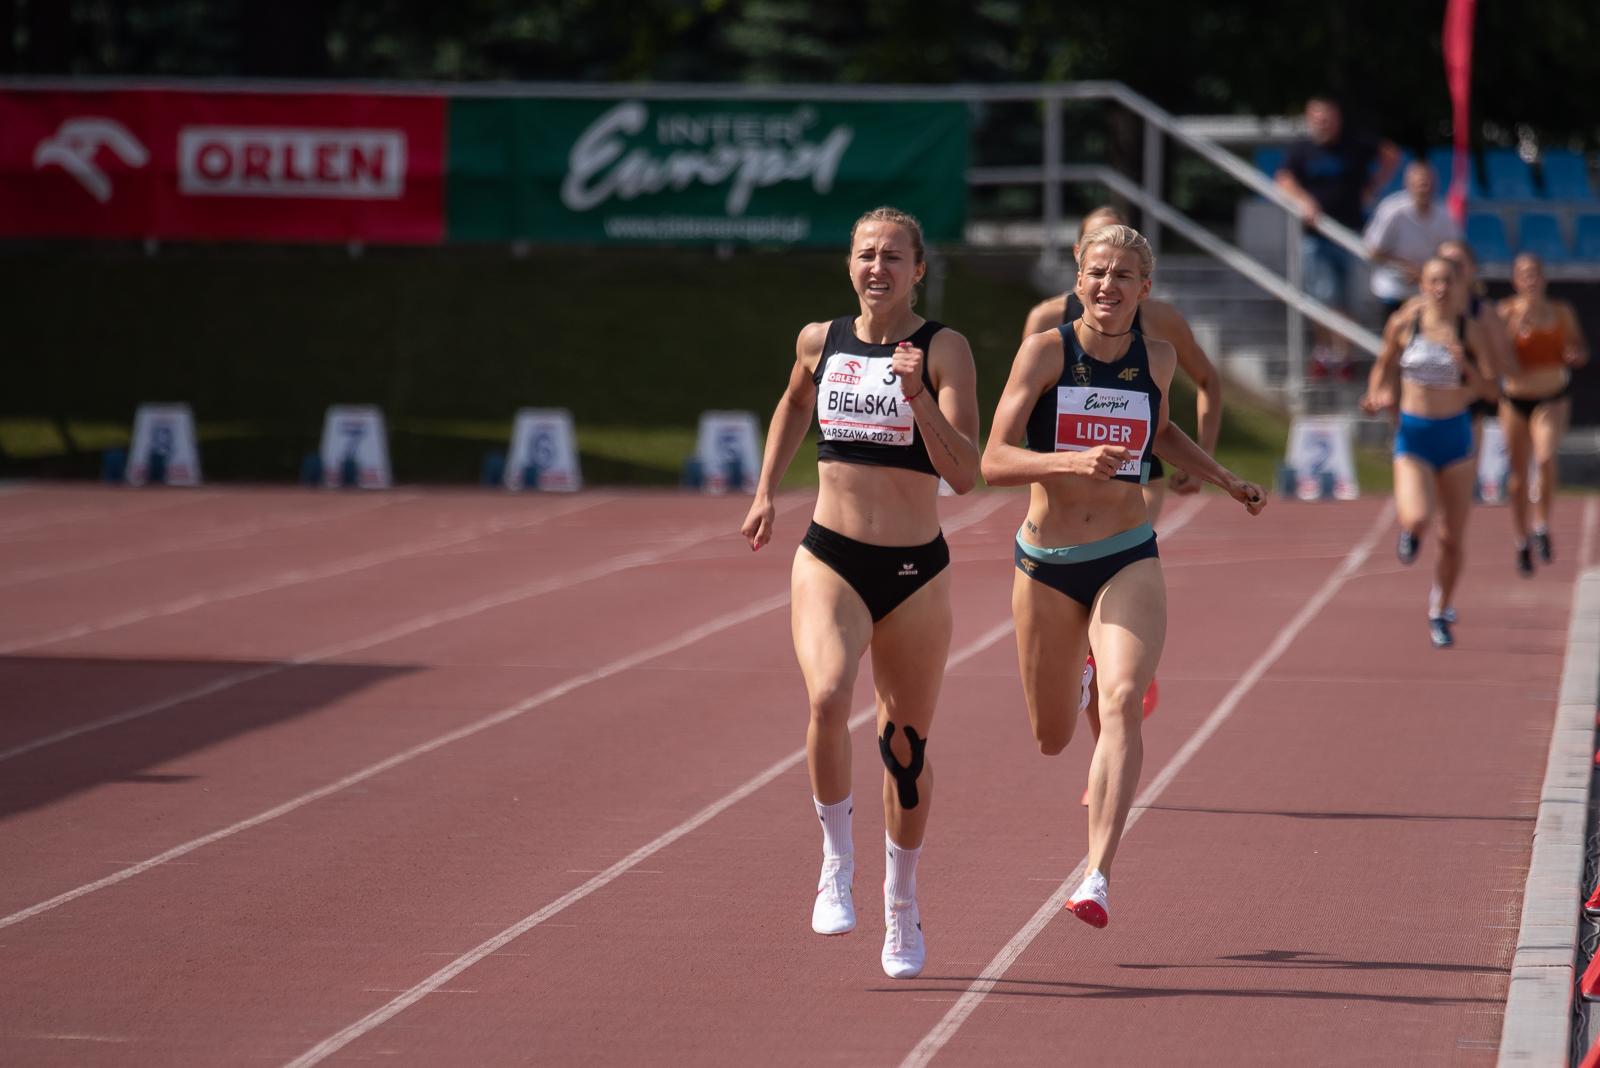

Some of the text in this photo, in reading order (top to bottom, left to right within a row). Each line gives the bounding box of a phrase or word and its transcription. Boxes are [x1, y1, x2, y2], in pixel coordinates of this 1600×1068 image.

[656, 112, 801, 146] INTER
[196, 142, 387, 186] ORLEN
[561, 102, 853, 215] Europol
[829, 373, 859, 385] ORLEN
[1117, 368, 1140, 381] 4F
[828, 390, 899, 418] BIELSKA
[1084, 392, 1130, 413] Europol
[871, 431, 894, 442] 2022
[1076, 422, 1132, 443] LIDER
[1020, 558, 1039, 572] 4F
